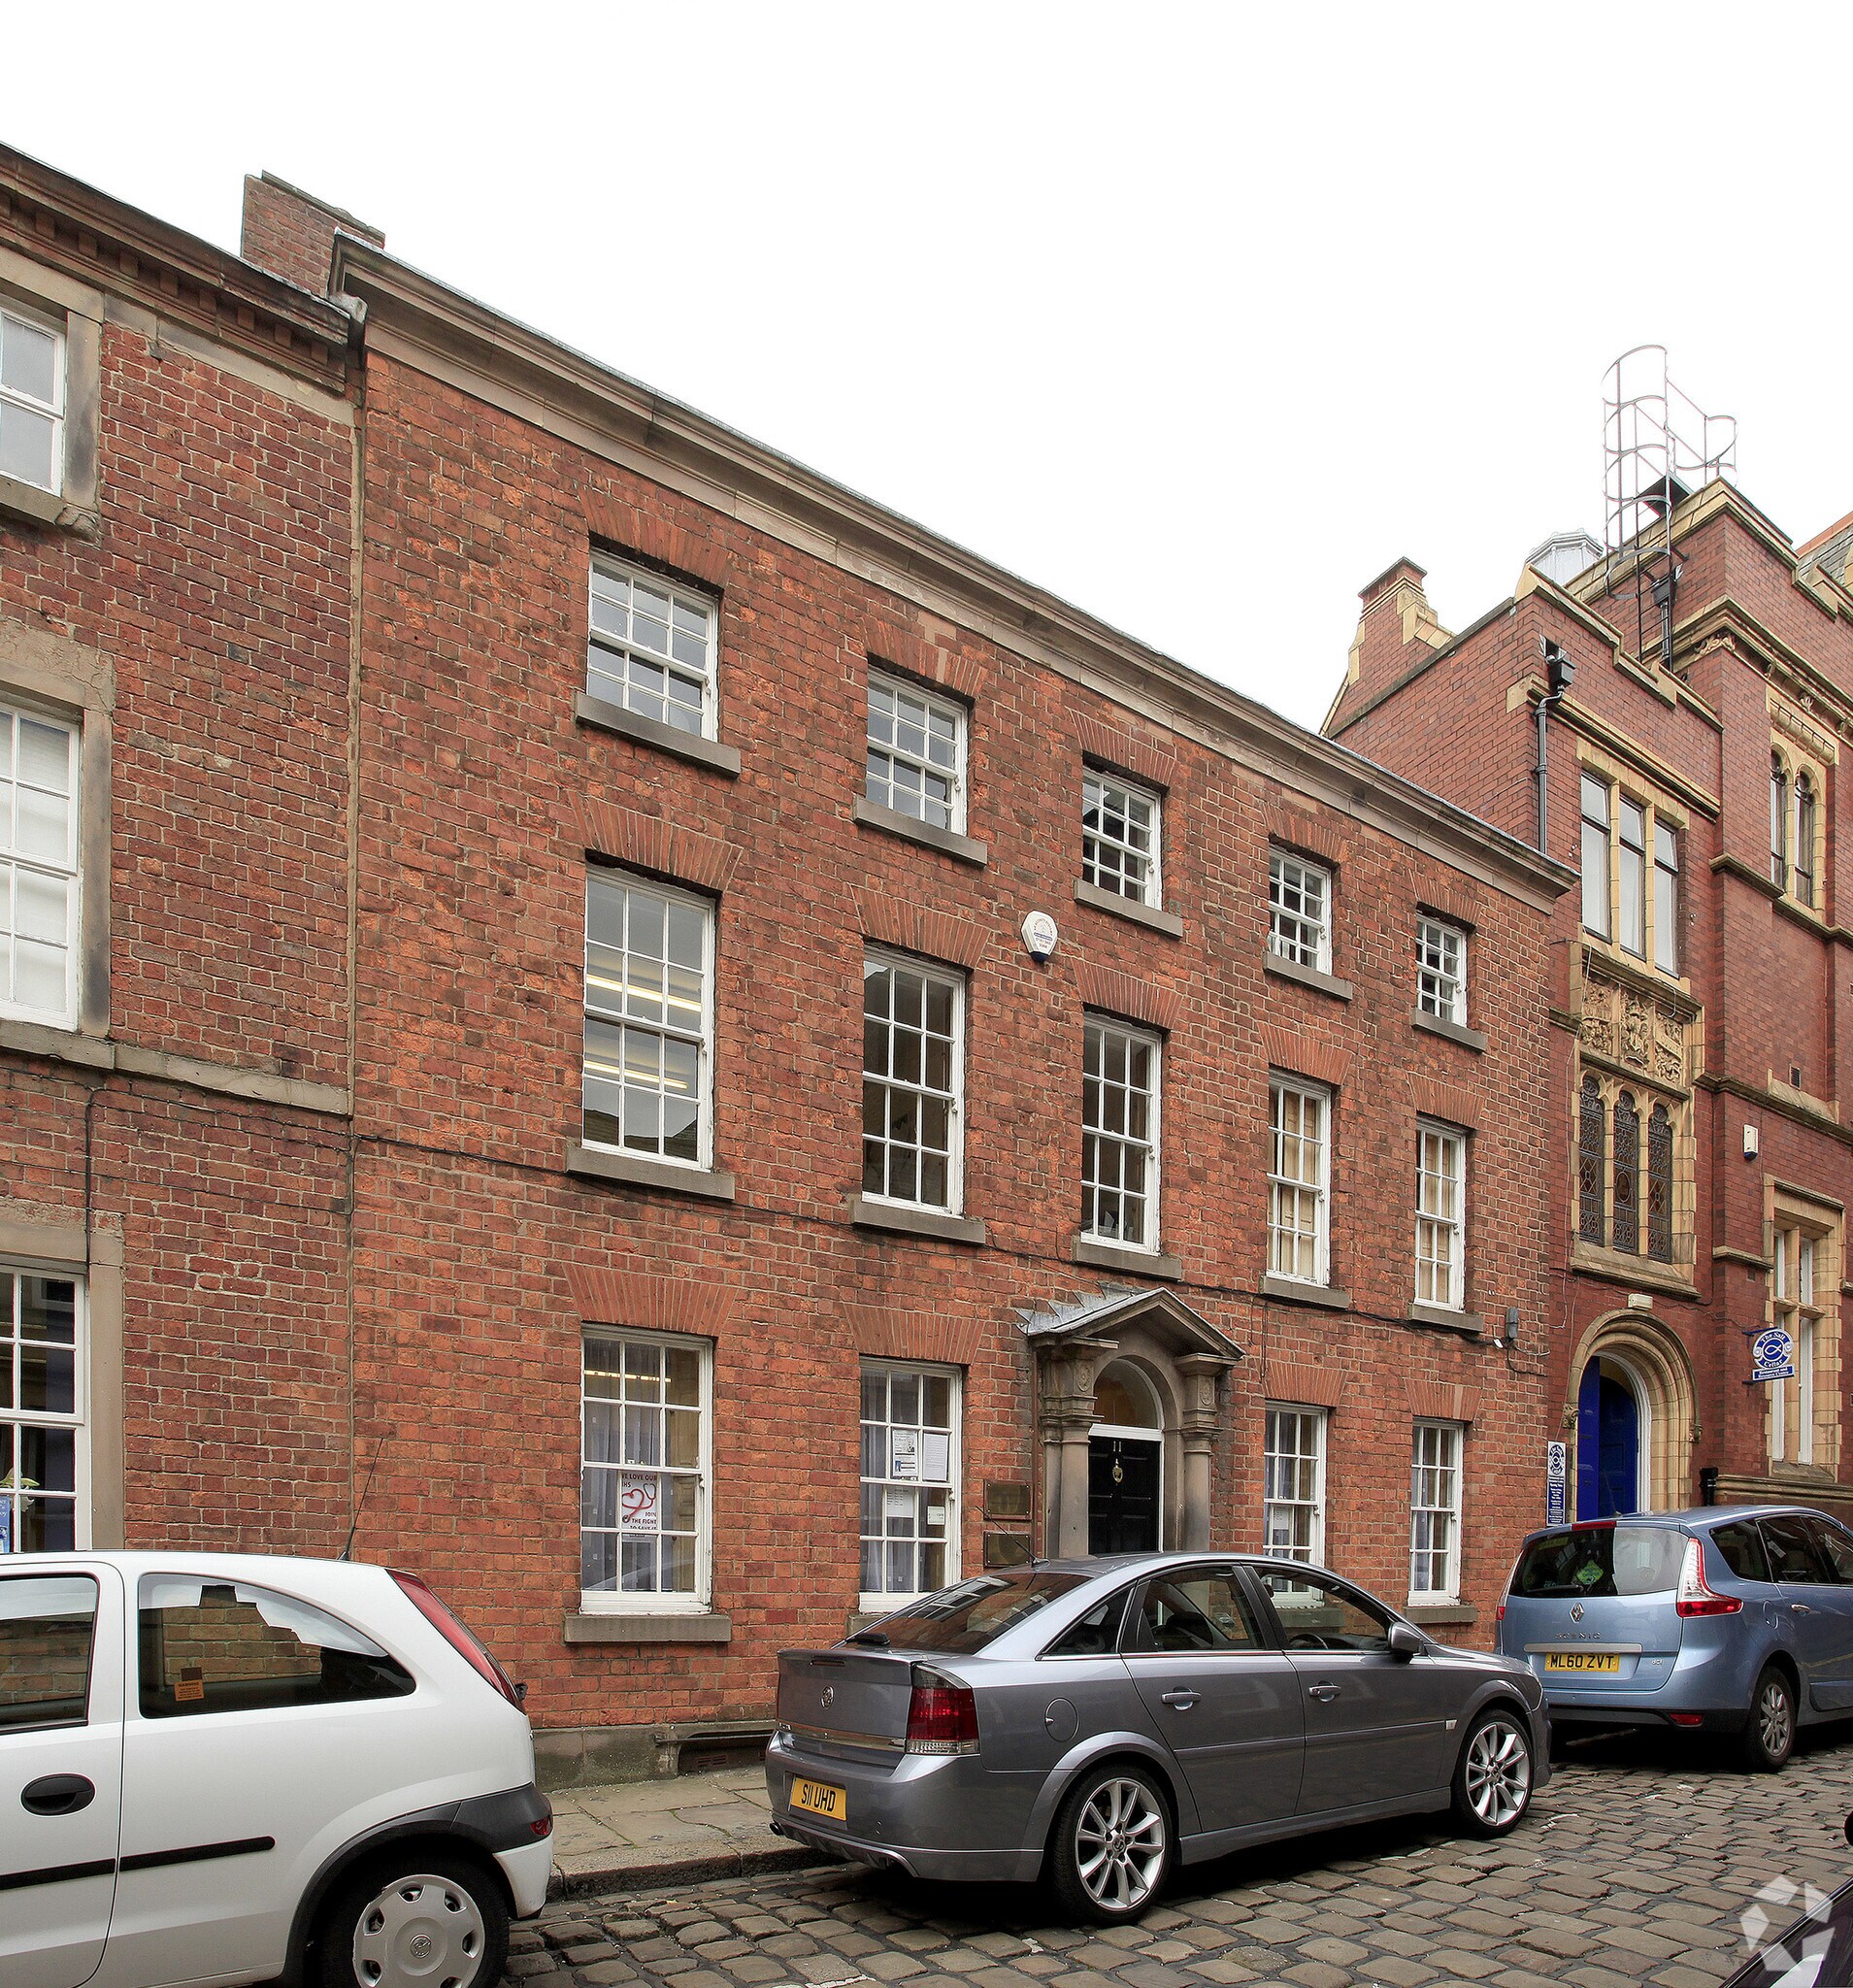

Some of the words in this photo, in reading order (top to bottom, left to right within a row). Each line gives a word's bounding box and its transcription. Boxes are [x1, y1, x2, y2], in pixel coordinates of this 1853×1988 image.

[1762, 1333, 1772, 1342] The
[1774, 1331, 1786, 1341] Salt
[1764, 1359, 1783, 1368] Cellar
[1550, 1654, 1583, 1669] ML60
[1586, 1655, 1614, 1670] ZVT
[813, 1786, 836, 1812] UHD
